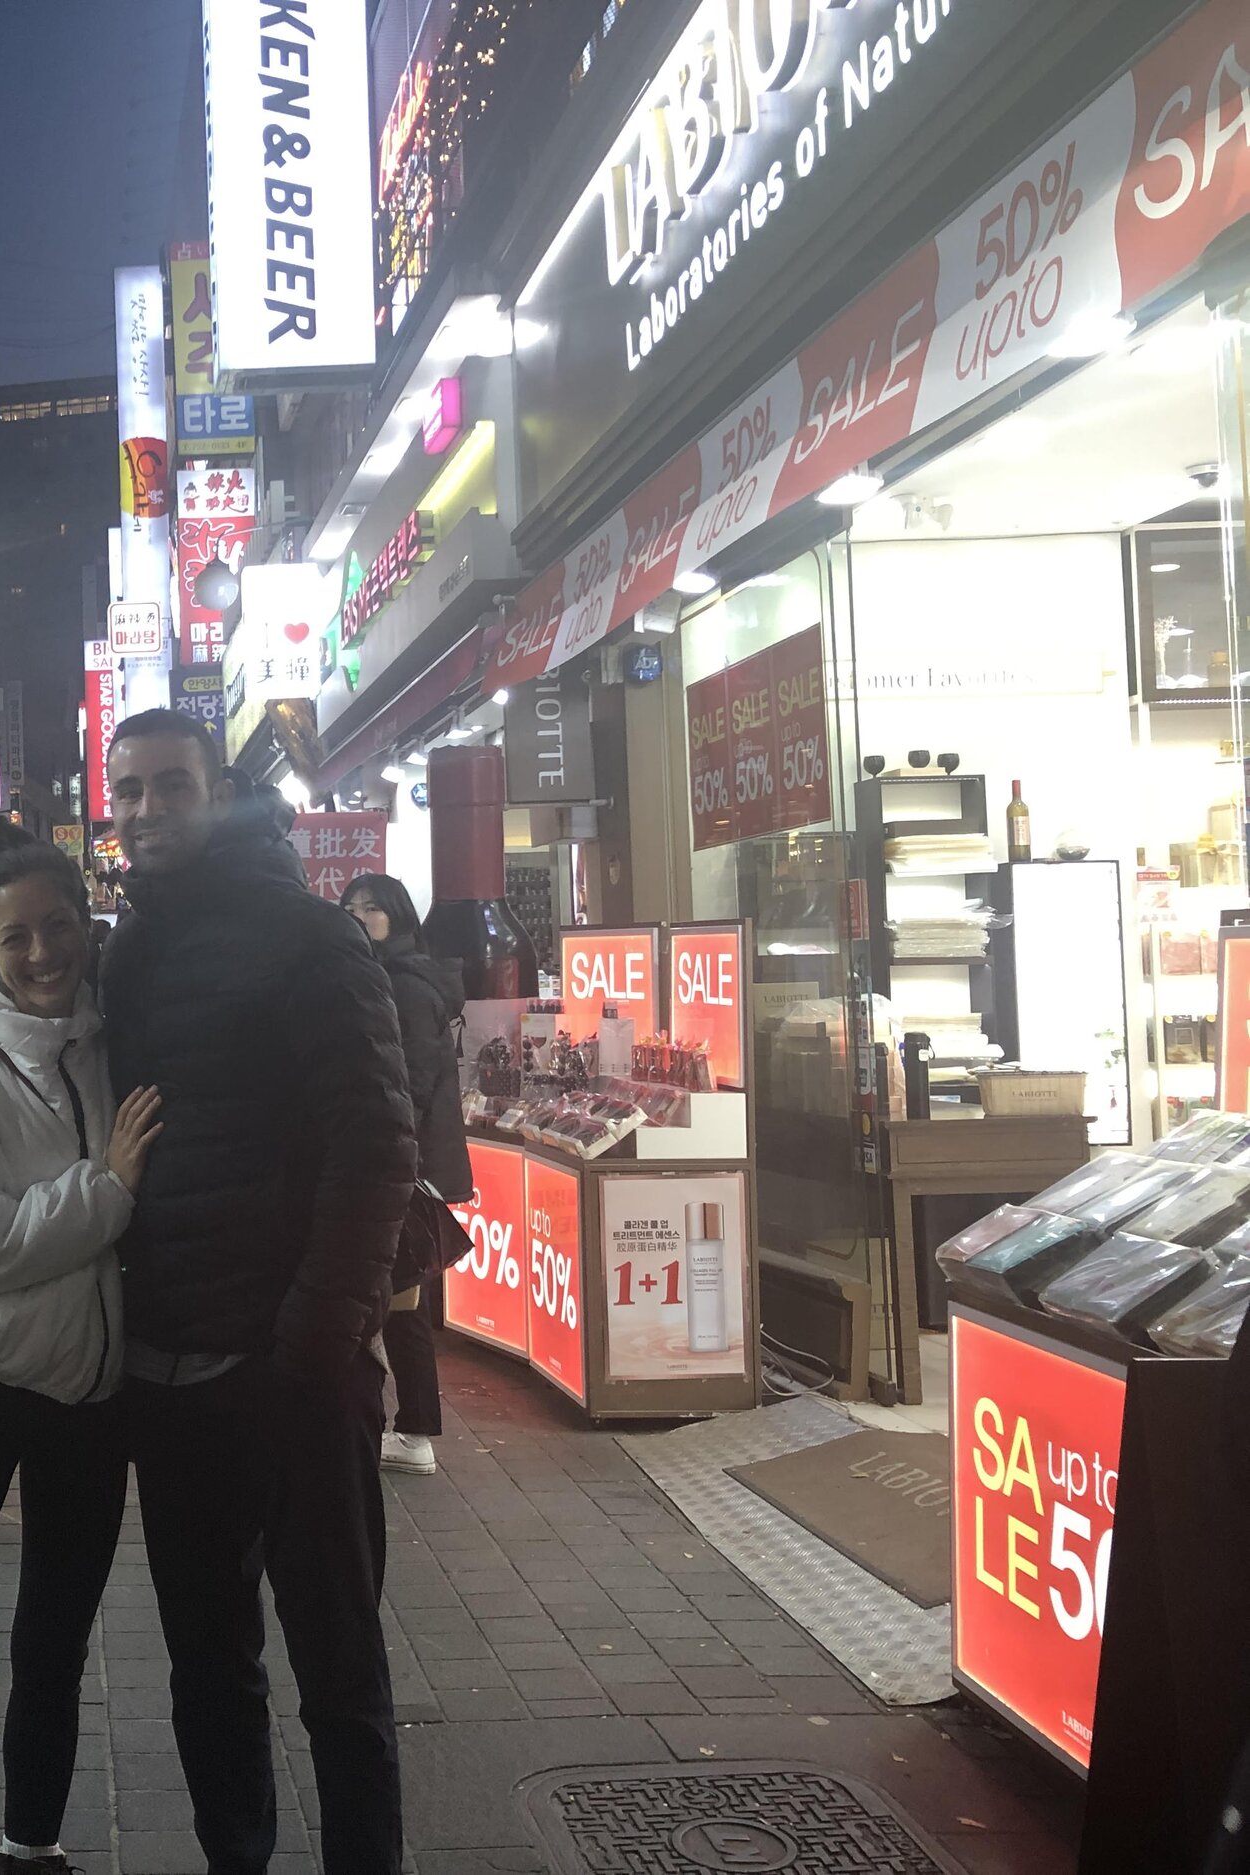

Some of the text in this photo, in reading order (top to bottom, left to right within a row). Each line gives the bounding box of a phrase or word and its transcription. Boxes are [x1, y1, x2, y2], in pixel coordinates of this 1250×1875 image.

[626, 0, 951, 372] Laboratories of Natu
[975, 140, 1083, 300] 50%
[794, 299, 924, 465] SALE
[183, 396, 249, 434] 타로
[718, 396, 777, 494] 50%
[620, 485, 695, 594] SALE
[574, 533, 611, 605] 50%
[115, 630, 156, 645] 마라탕
[497, 594, 562, 667] SALE
[100, 673, 113, 707] STAR
[732, 688, 770, 735] SALE
[778, 666, 821, 717] SALE
[691, 706, 726, 750] SALE
[736, 753, 773, 804] 50%
[783, 735, 823, 790] 50%
[694, 767, 728, 815] 50%
[570, 951, 646, 1000] SALE
[678, 951, 734, 1006] SALE
[616, 1241, 678, 1253] 胶原蛋白精华
[655, 1230, 681, 1240] 에센스
[531, 1238, 577, 1330] 50%
[613, 1259, 684, 1306] 1+1
[972, 1397, 1045, 1518] SA
[1047, 1441, 1088, 1502] up
[975, 1495, 1041, 1621] LE
